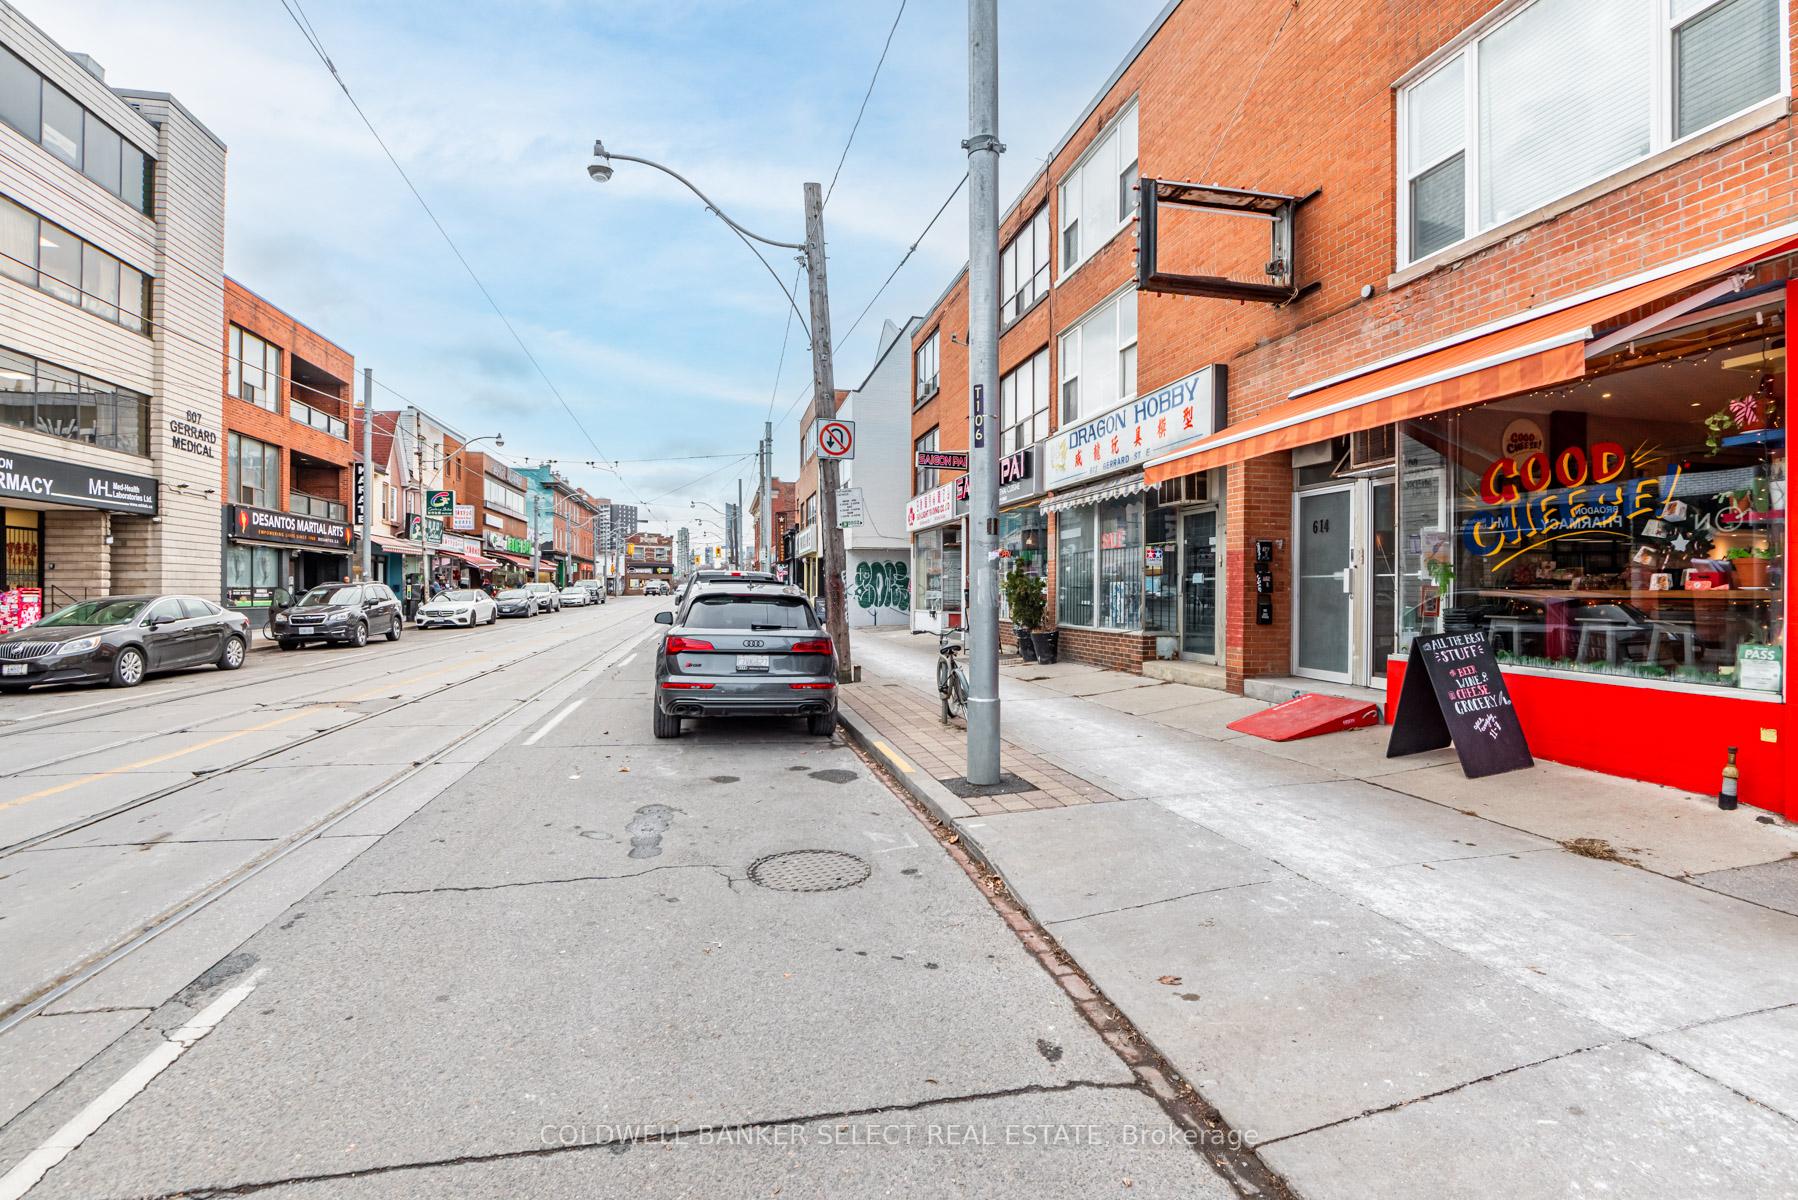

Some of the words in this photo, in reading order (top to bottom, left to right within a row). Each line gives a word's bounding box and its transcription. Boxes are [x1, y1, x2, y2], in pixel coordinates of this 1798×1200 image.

[186, 411, 202, 424] 607
[1069, 410, 1127, 450] DRAGON
[1135, 377, 1199, 423] HOBBY
[170, 420, 216, 444] GERRARD
[1510, 432, 1535, 443] GOOD
[172, 437, 215, 459] MEDICAL
[919, 454, 951, 466] SAIGON
[1001, 450, 1024, 485] PAI
[1103, 455, 1130, 470] GERRARD
[1480, 442, 1626, 505] GOOD
[0, 471, 54, 495] RMACY
[112, 482, 140, 493] Med-Health
[112, 490, 143, 502] Laboratories
[252, 512, 296, 531] DESANTOS
[296, 519, 327, 535] MARTIAL
[327, 525, 344, 538] ARTS
[1312, 519, 1330, 534] 614
[1431, 638, 1449, 650] ALL
[1446, 635, 1465, 647] THE
[1464, 632, 1485, 645] BEST
[1440, 645, 1477, 662] STUFF
[1744, 649, 1775, 660] PASS
[1457, 665, 1477, 677] BEER
[1455, 675, 1482, 689] WINE
[1455, 684, 1491, 700] CHEESE
[1454, 694, 1497, 715] GROCERY
